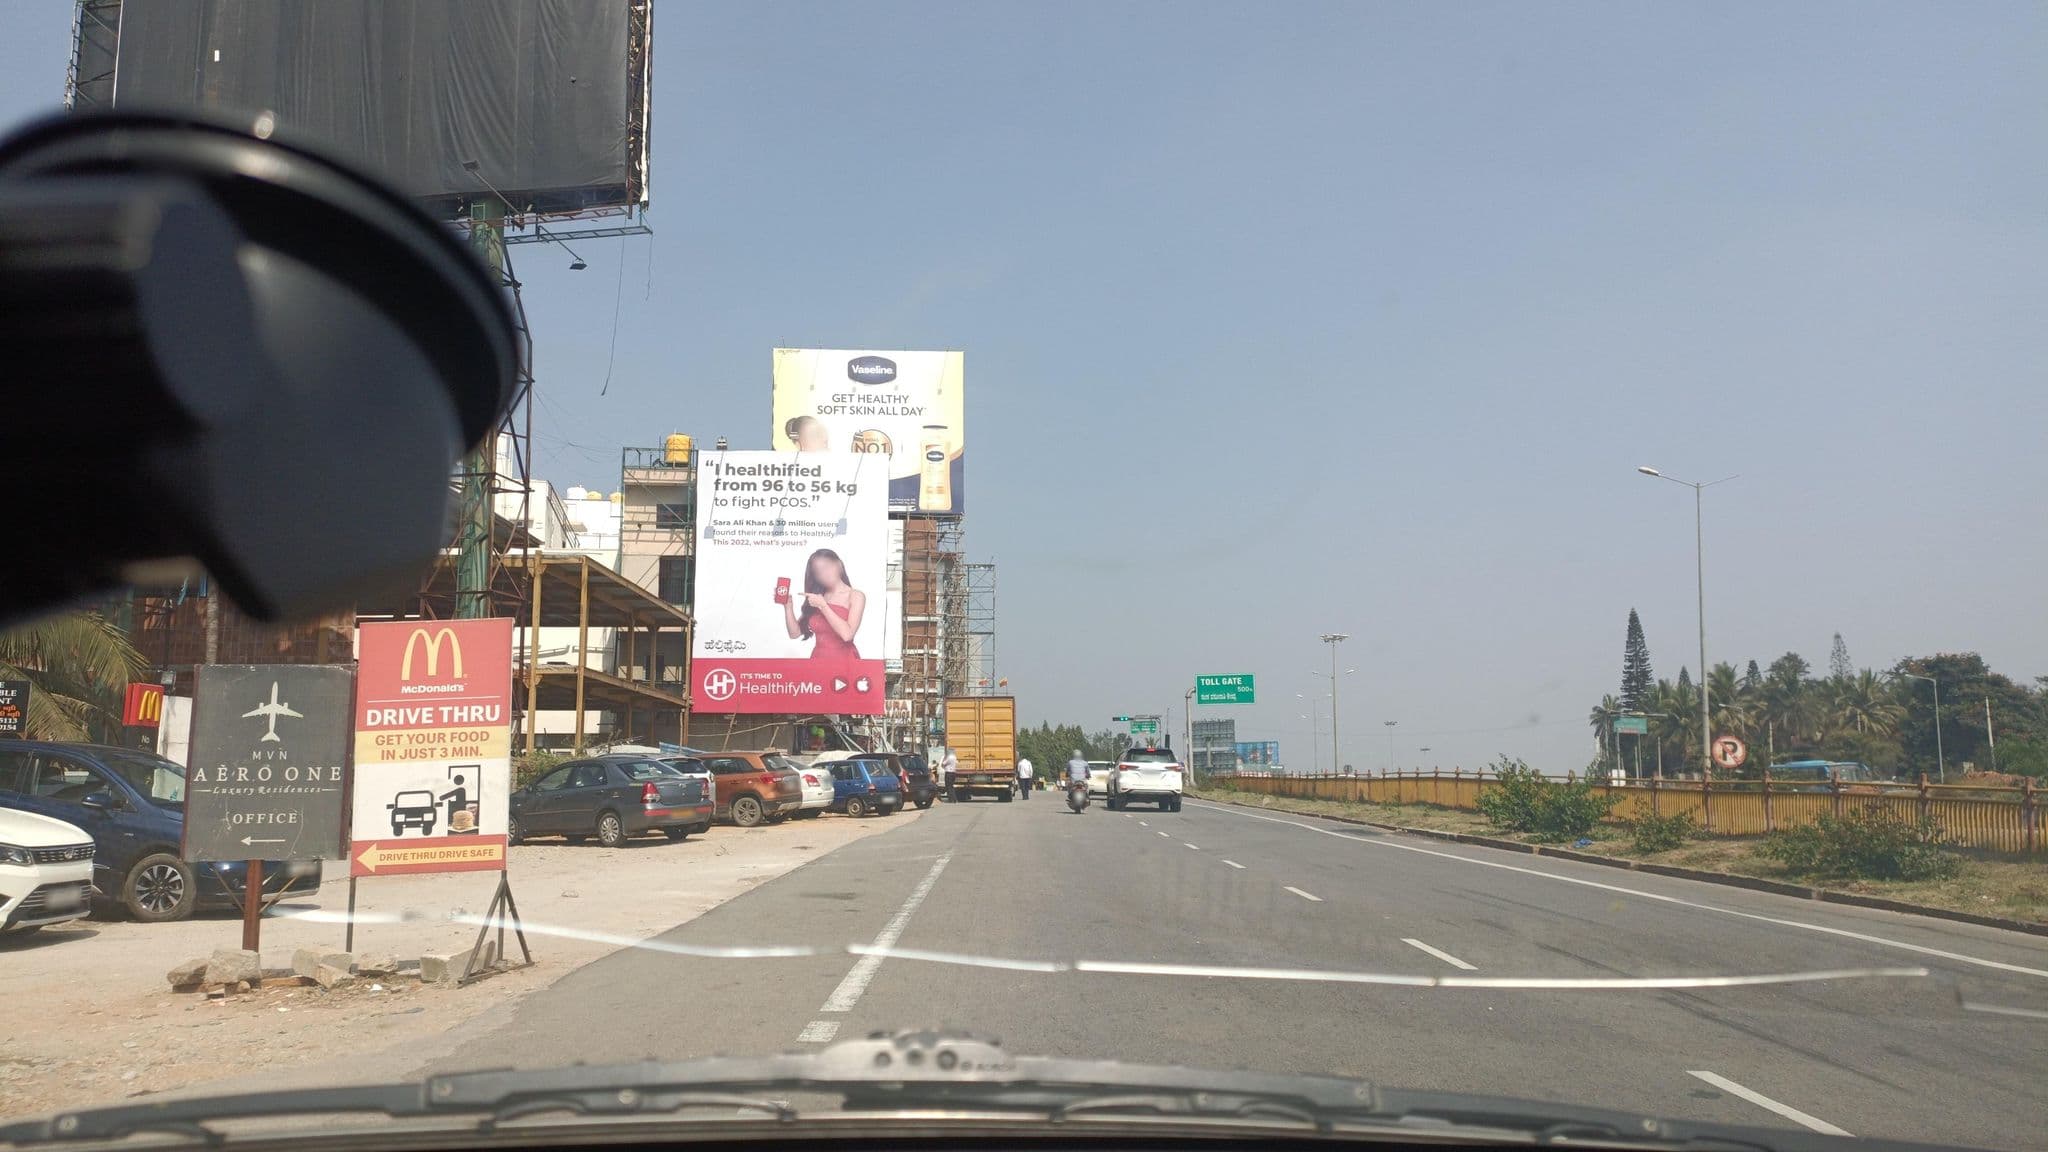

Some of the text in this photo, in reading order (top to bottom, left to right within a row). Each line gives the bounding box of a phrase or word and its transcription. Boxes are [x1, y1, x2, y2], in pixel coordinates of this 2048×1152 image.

[852, 364, 894, 375] Vaseline
[832, 393, 910, 404] GET HEALTHY
[817, 405, 846, 415] SOFT
[849, 405, 875, 415] SKIN
[877, 406, 898, 416] ALL
[725, 463, 821, 477] healthified
[714, 478, 857, 496] from 96 to 56 kg
[714, 497, 728, 507] to
[732, 496, 766, 509] fight
[713, 519, 731, 527] Sara
[733, 519, 744, 527] Ali
[746, 519, 767, 527] Khan
[713, 529, 736, 537] found
[738, 529, 756, 537] their
[781, 540, 807, 548] yours?
[1200, 677, 1242, 686] TOLL GATE
[401, 684, 465, 694] McDonald's
[740, 682, 822, 696] HealthifyMe
[366, 704, 501, 727] DRIVE THRU
[375, 731, 490, 746] GET YOUR FOOD
[381, 746, 484, 761] IN JUST 3 MIN.
[284, 766, 341, 782] ONE
[212, 785, 321, 796] Luxury Residences
[232, 813, 298, 824] OFFICE
[379, 849, 494, 862] DRIVE THRU DRIVE SAFE
